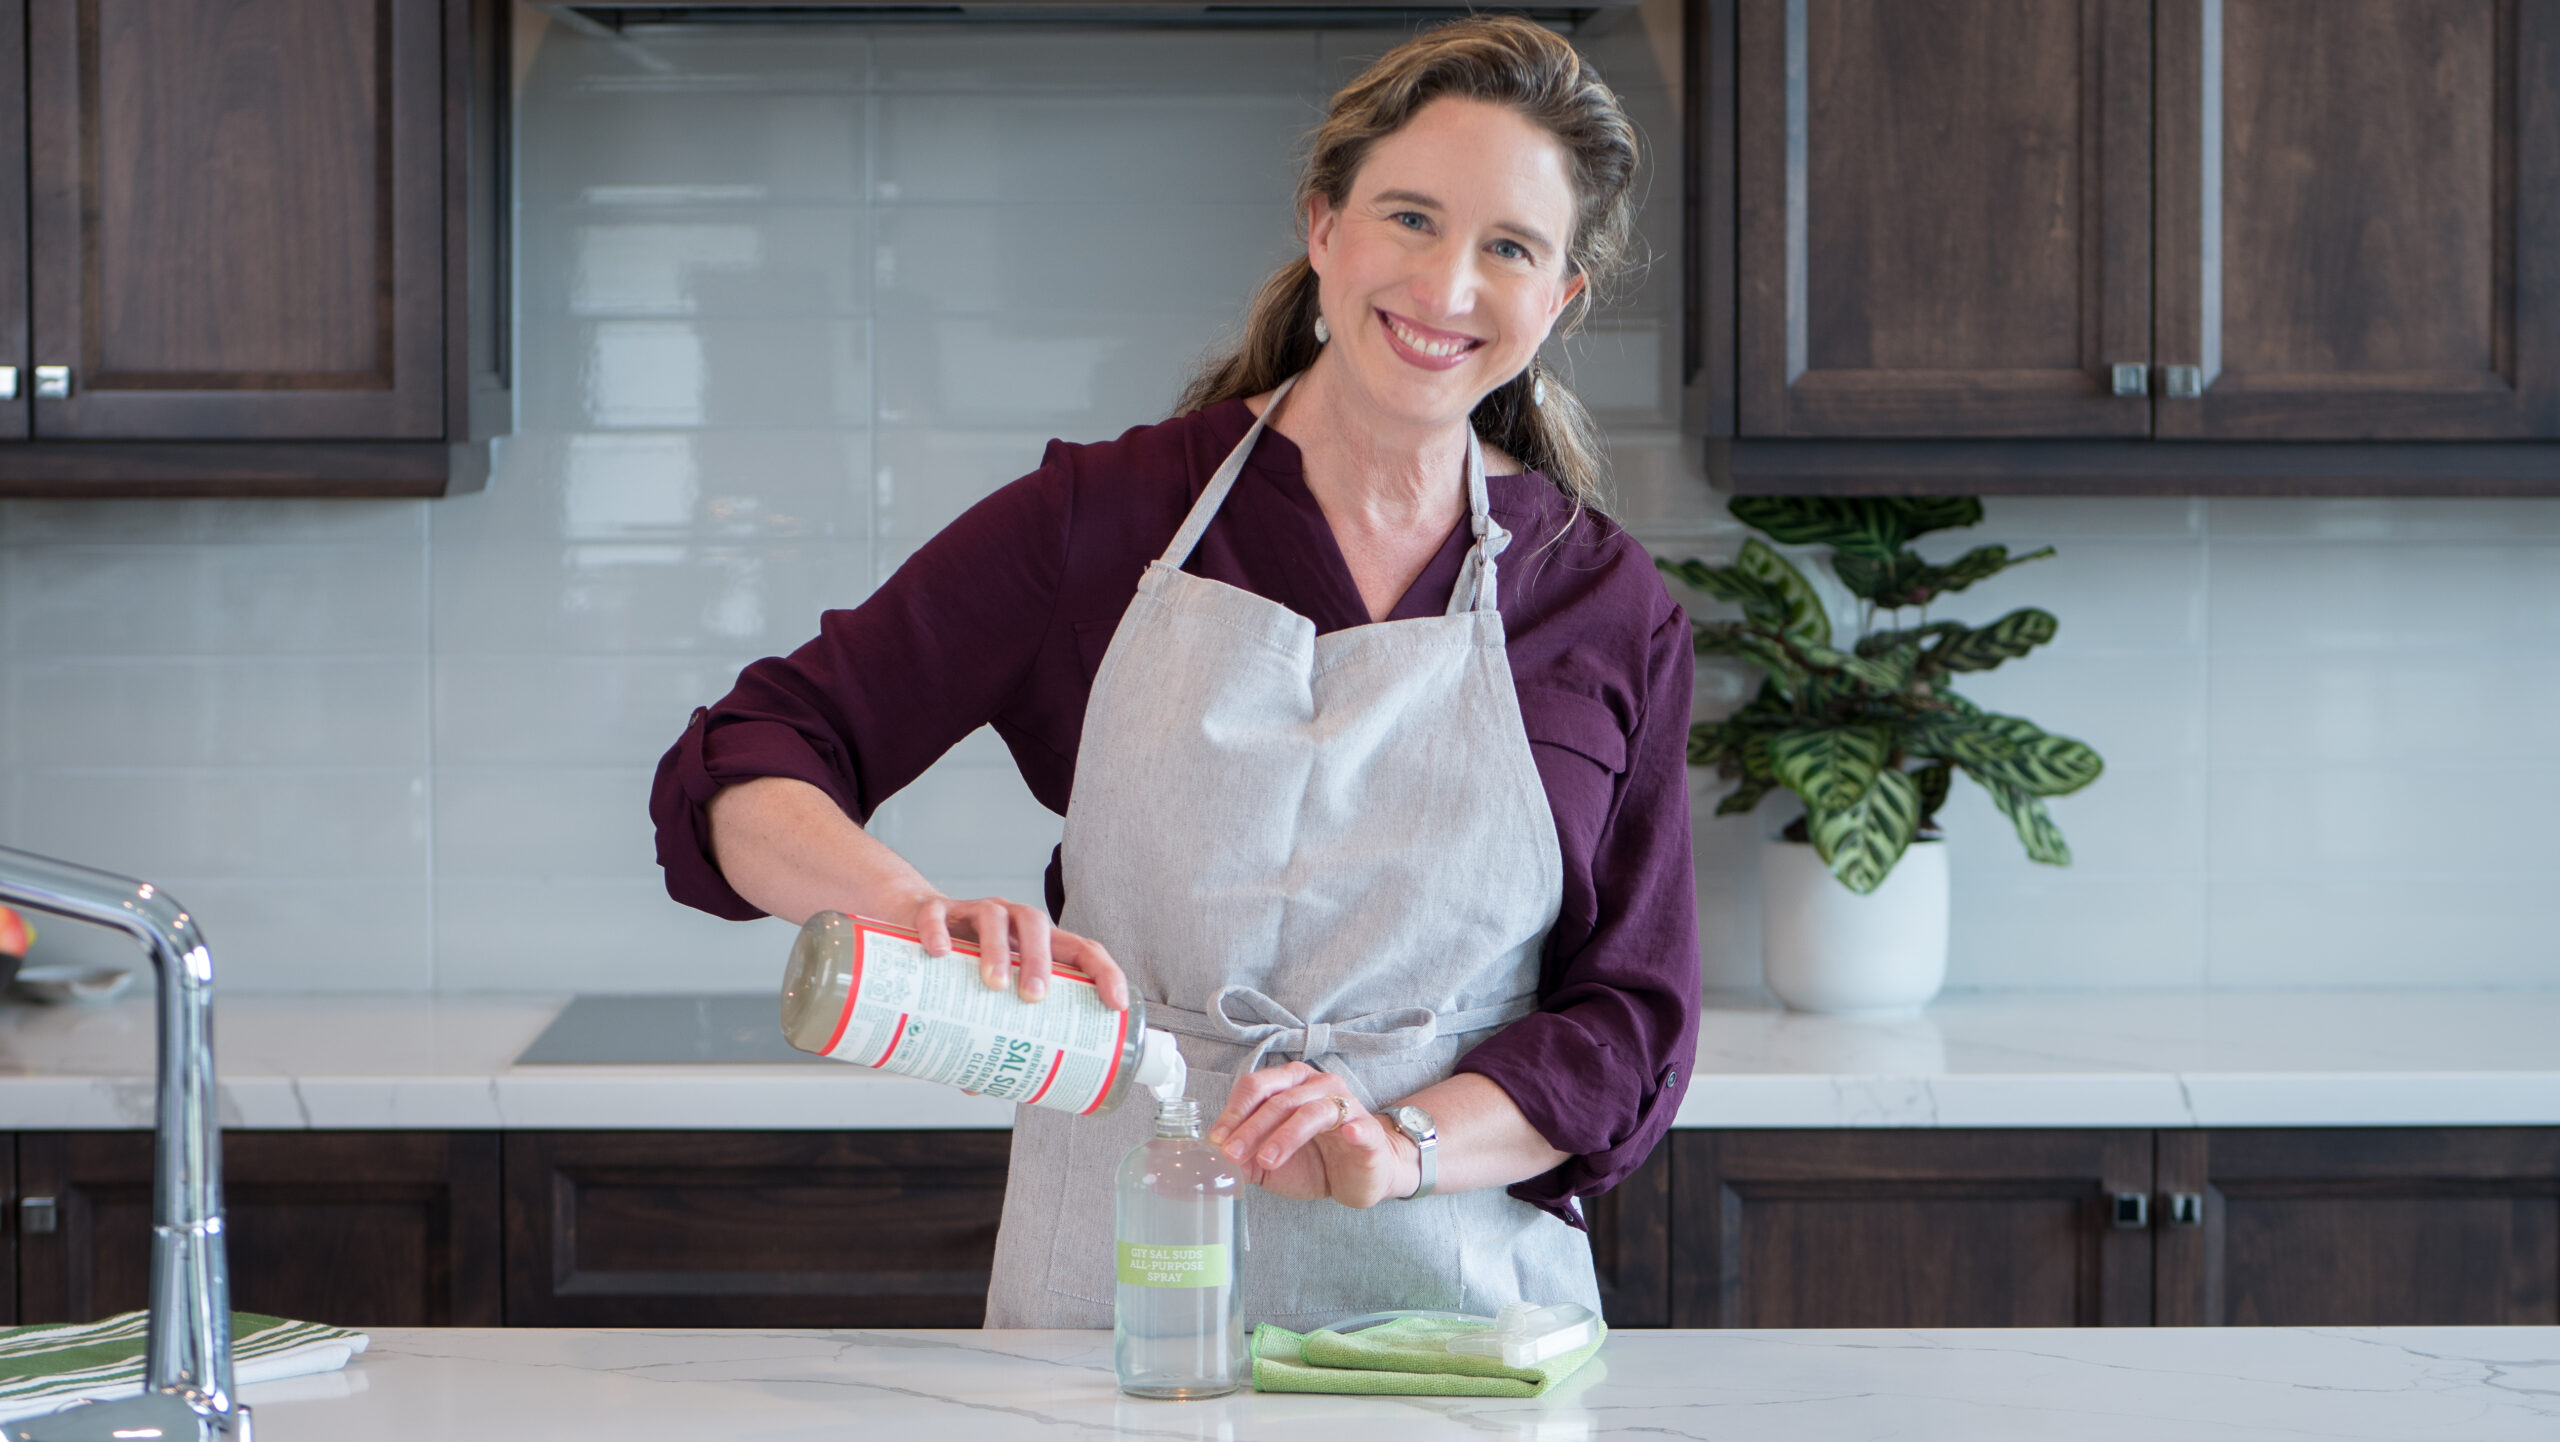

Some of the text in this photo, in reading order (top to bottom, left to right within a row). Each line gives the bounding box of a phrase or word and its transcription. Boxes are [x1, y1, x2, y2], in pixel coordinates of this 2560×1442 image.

[999, 1039, 1032, 1072] SAL
[958, 1052, 985, 1085] CLEANER
[1130, 1247, 1204, 1260] GIY SAL SUDS
[1129, 1259, 1205, 1271] ALL-PURPOSE
[1146, 1272, 1184, 1283] SPRAY
